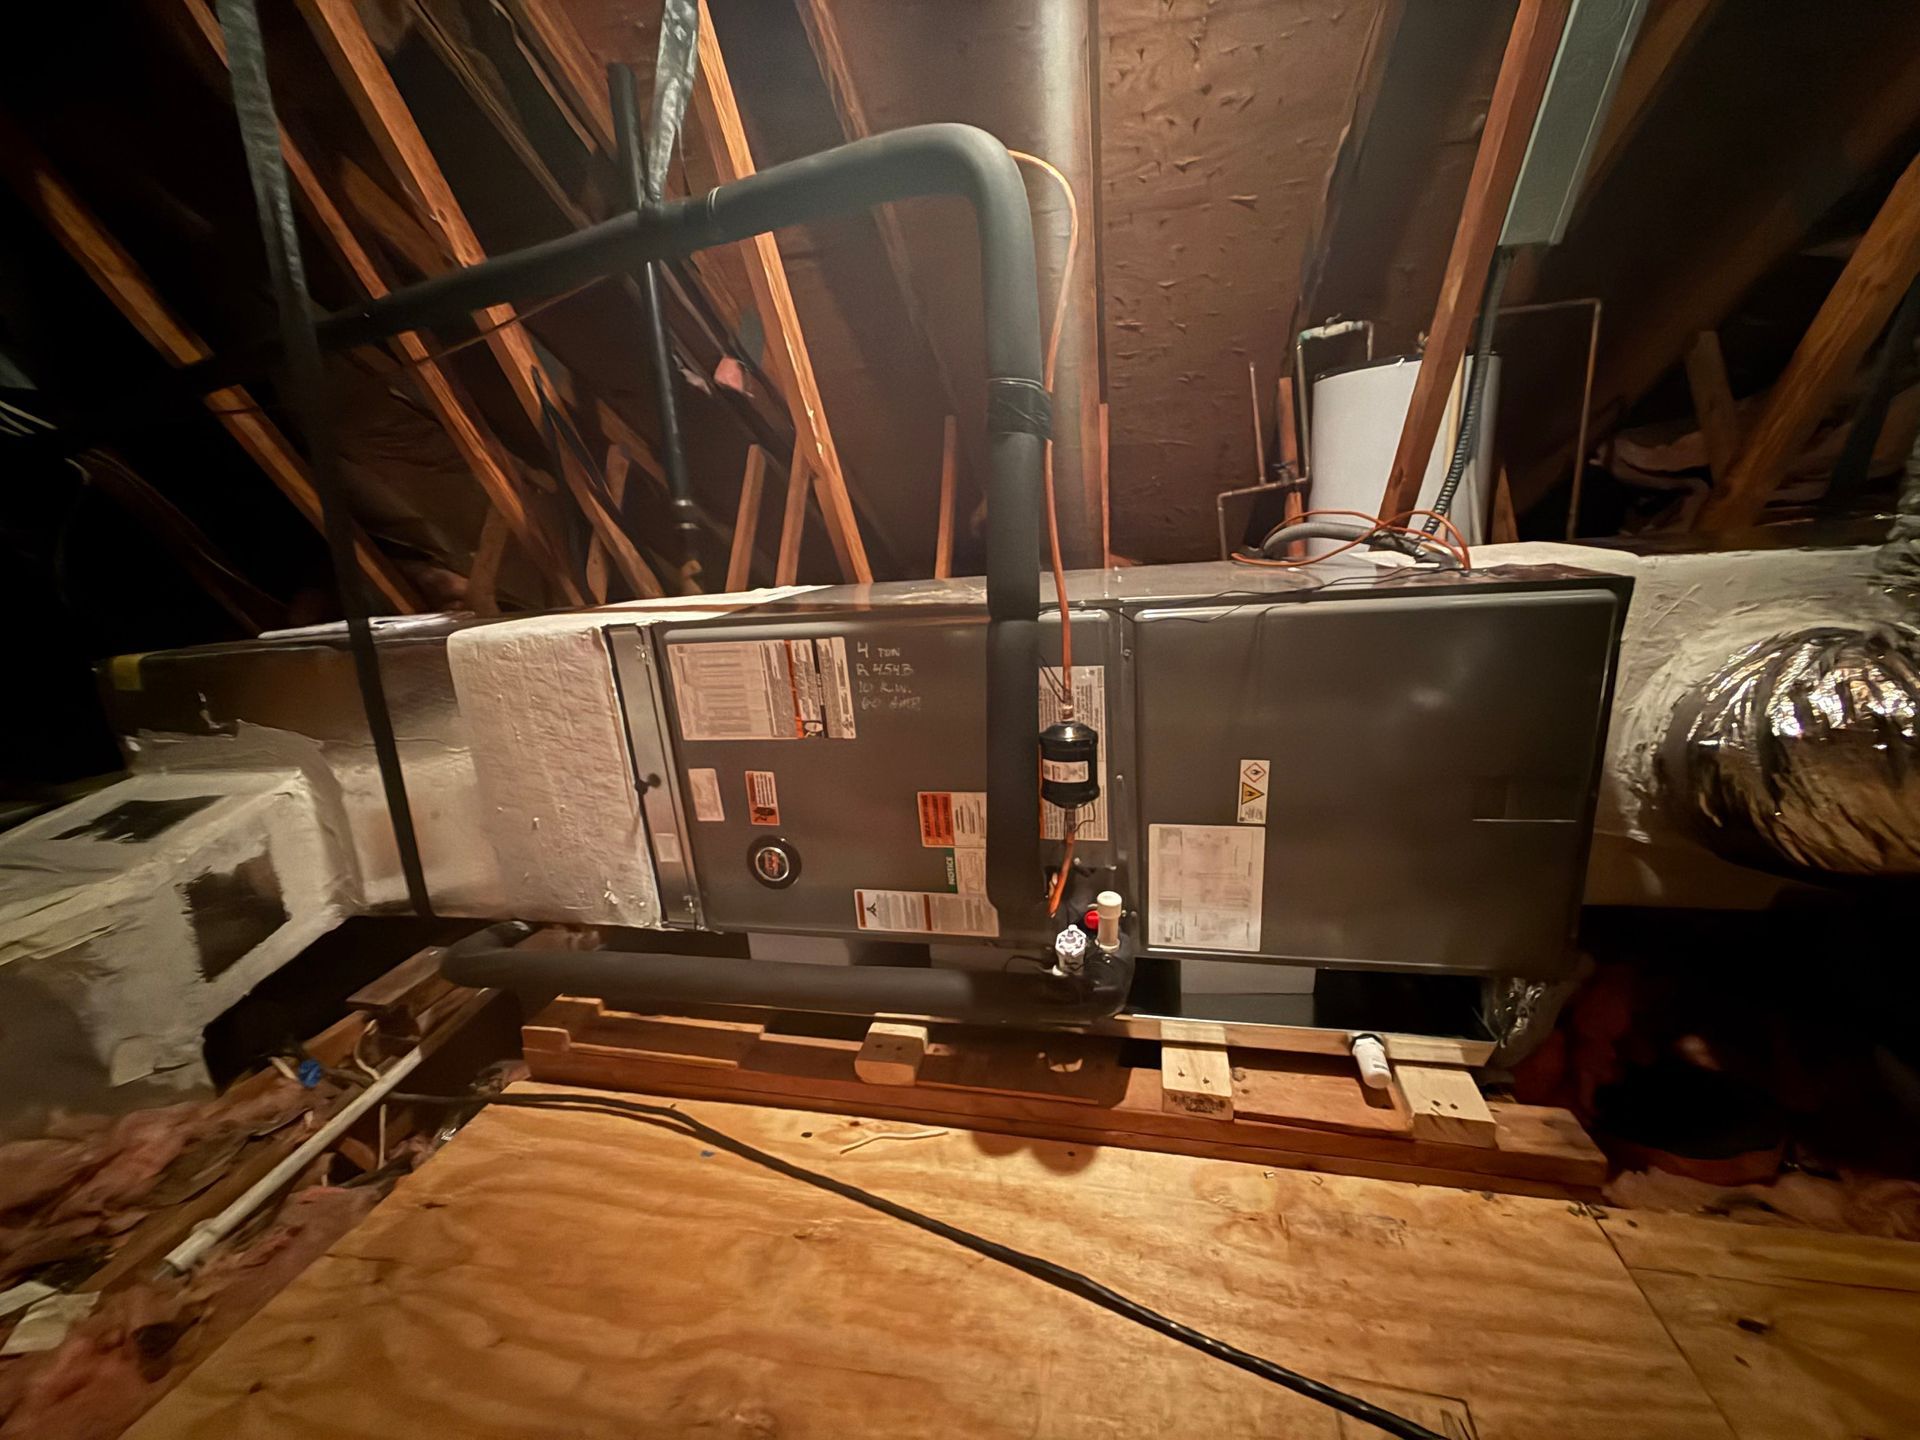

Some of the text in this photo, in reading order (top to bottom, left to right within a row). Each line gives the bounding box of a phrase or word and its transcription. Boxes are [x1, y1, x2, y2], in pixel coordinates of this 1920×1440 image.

[857, 641, 900, 659] 4 TON
[856, 663, 870, 677] R
[946, 857, 956, 885] NOTICE
